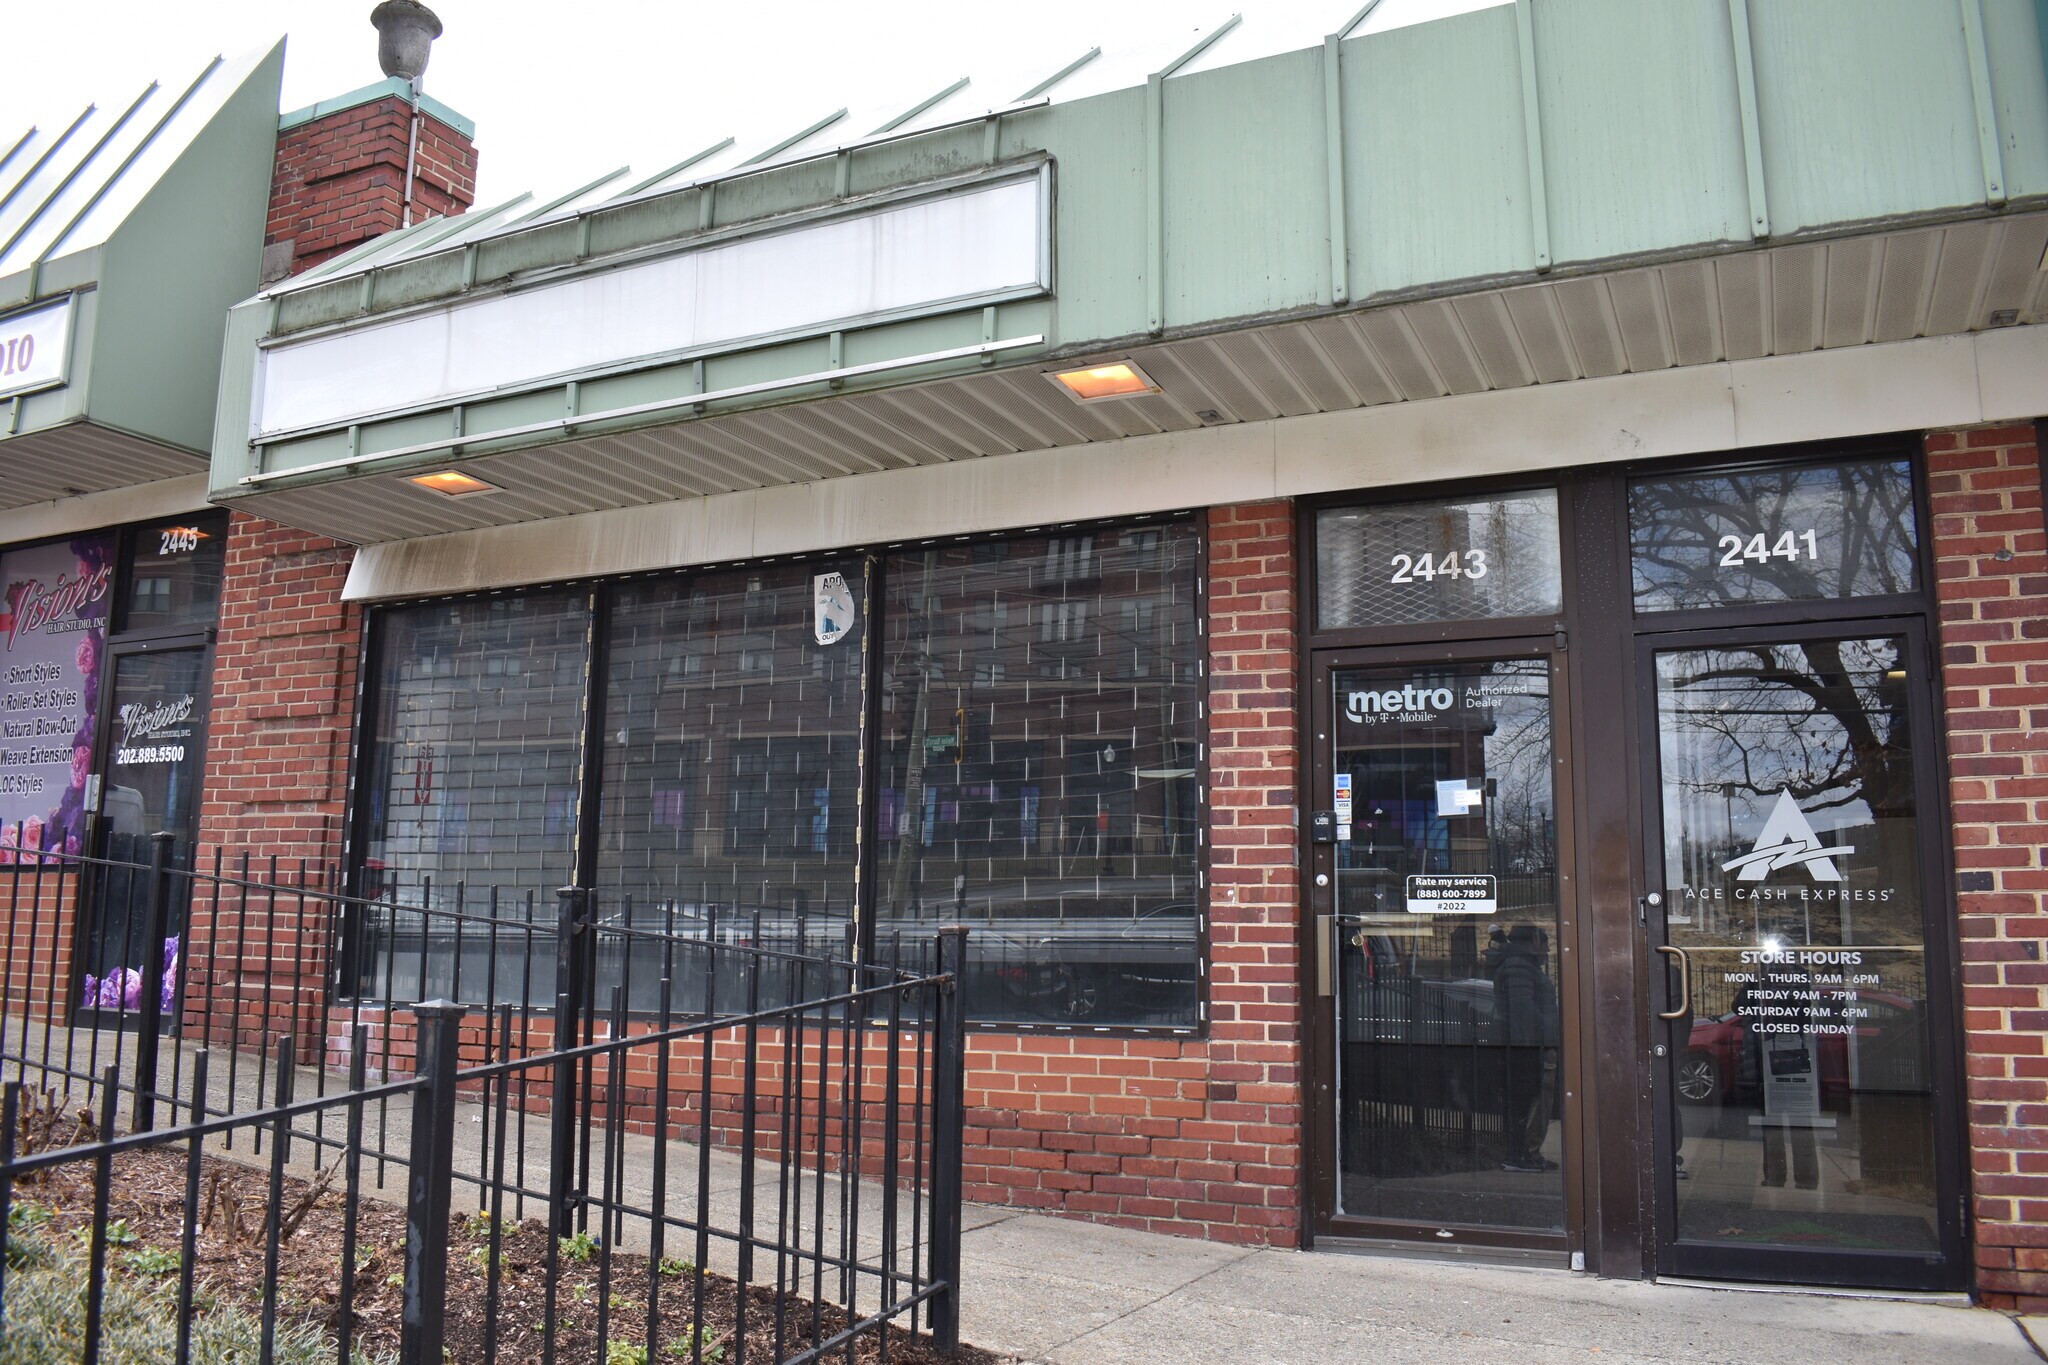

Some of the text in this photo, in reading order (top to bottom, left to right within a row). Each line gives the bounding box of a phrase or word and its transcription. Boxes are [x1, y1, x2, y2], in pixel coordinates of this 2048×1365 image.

[160, 526, 198, 556] 2445
[1718, 528, 1819, 567] 2441
[1390, 549, 1488, 584] 2443
[5, 562, 113, 652] Vision's
[47, 620, 65, 634] HAIR
[65, 617, 92, 631] STUDIO,
[9, 662, 61, 685] Short Styles
[1348, 684, 1454, 713] metro
[1465, 684, 1528, 697] Authorized
[6, 687, 77, 712] Roller Set Styles
[1466, 698, 1502, 708] Dealer
[3, 715, 77, 739] Natural Blow-Out
[119, 694, 194, 748] Vision's
[1365, 713, 1377, 726] by
[0, 744, 74, 766] Weave Extension
[118, 746, 184, 764] 202.889.5500
[0, 774, 43, 797] OC Styles
[1416, 878, 1436, 886] Rate
[1455, 877, 1487, 886] service
[1417, 890, 1486, 898] (888) 600-7899
[1685, 888, 1723, 899] ACE
[1735, 888, 1788, 900] CASH
[1438, 902, 1466, 910] #2022
[1740, 951, 1862, 965] STORE HOURS
[1724, 973, 1758, 983] MON.
[1768, 974, 1811, 984] THURS.
[1814, 974, 1843, 984] 9AM
[1852, 974, 1879, 984] 6PM
[1747, 991, 1790, 1000] FRIDAY
[1792, 991, 1820, 1000] 9AM
[1831, 991, 1857, 1001] 7PM
[1737, 1007, 1800, 1017] SATURDAY
[1803, 1007, 1831, 1017] 9AM
[1841, 1008, 1867, 1018] 6PM
[1752, 1024, 1854, 1035] CLOSED SUNDAY
